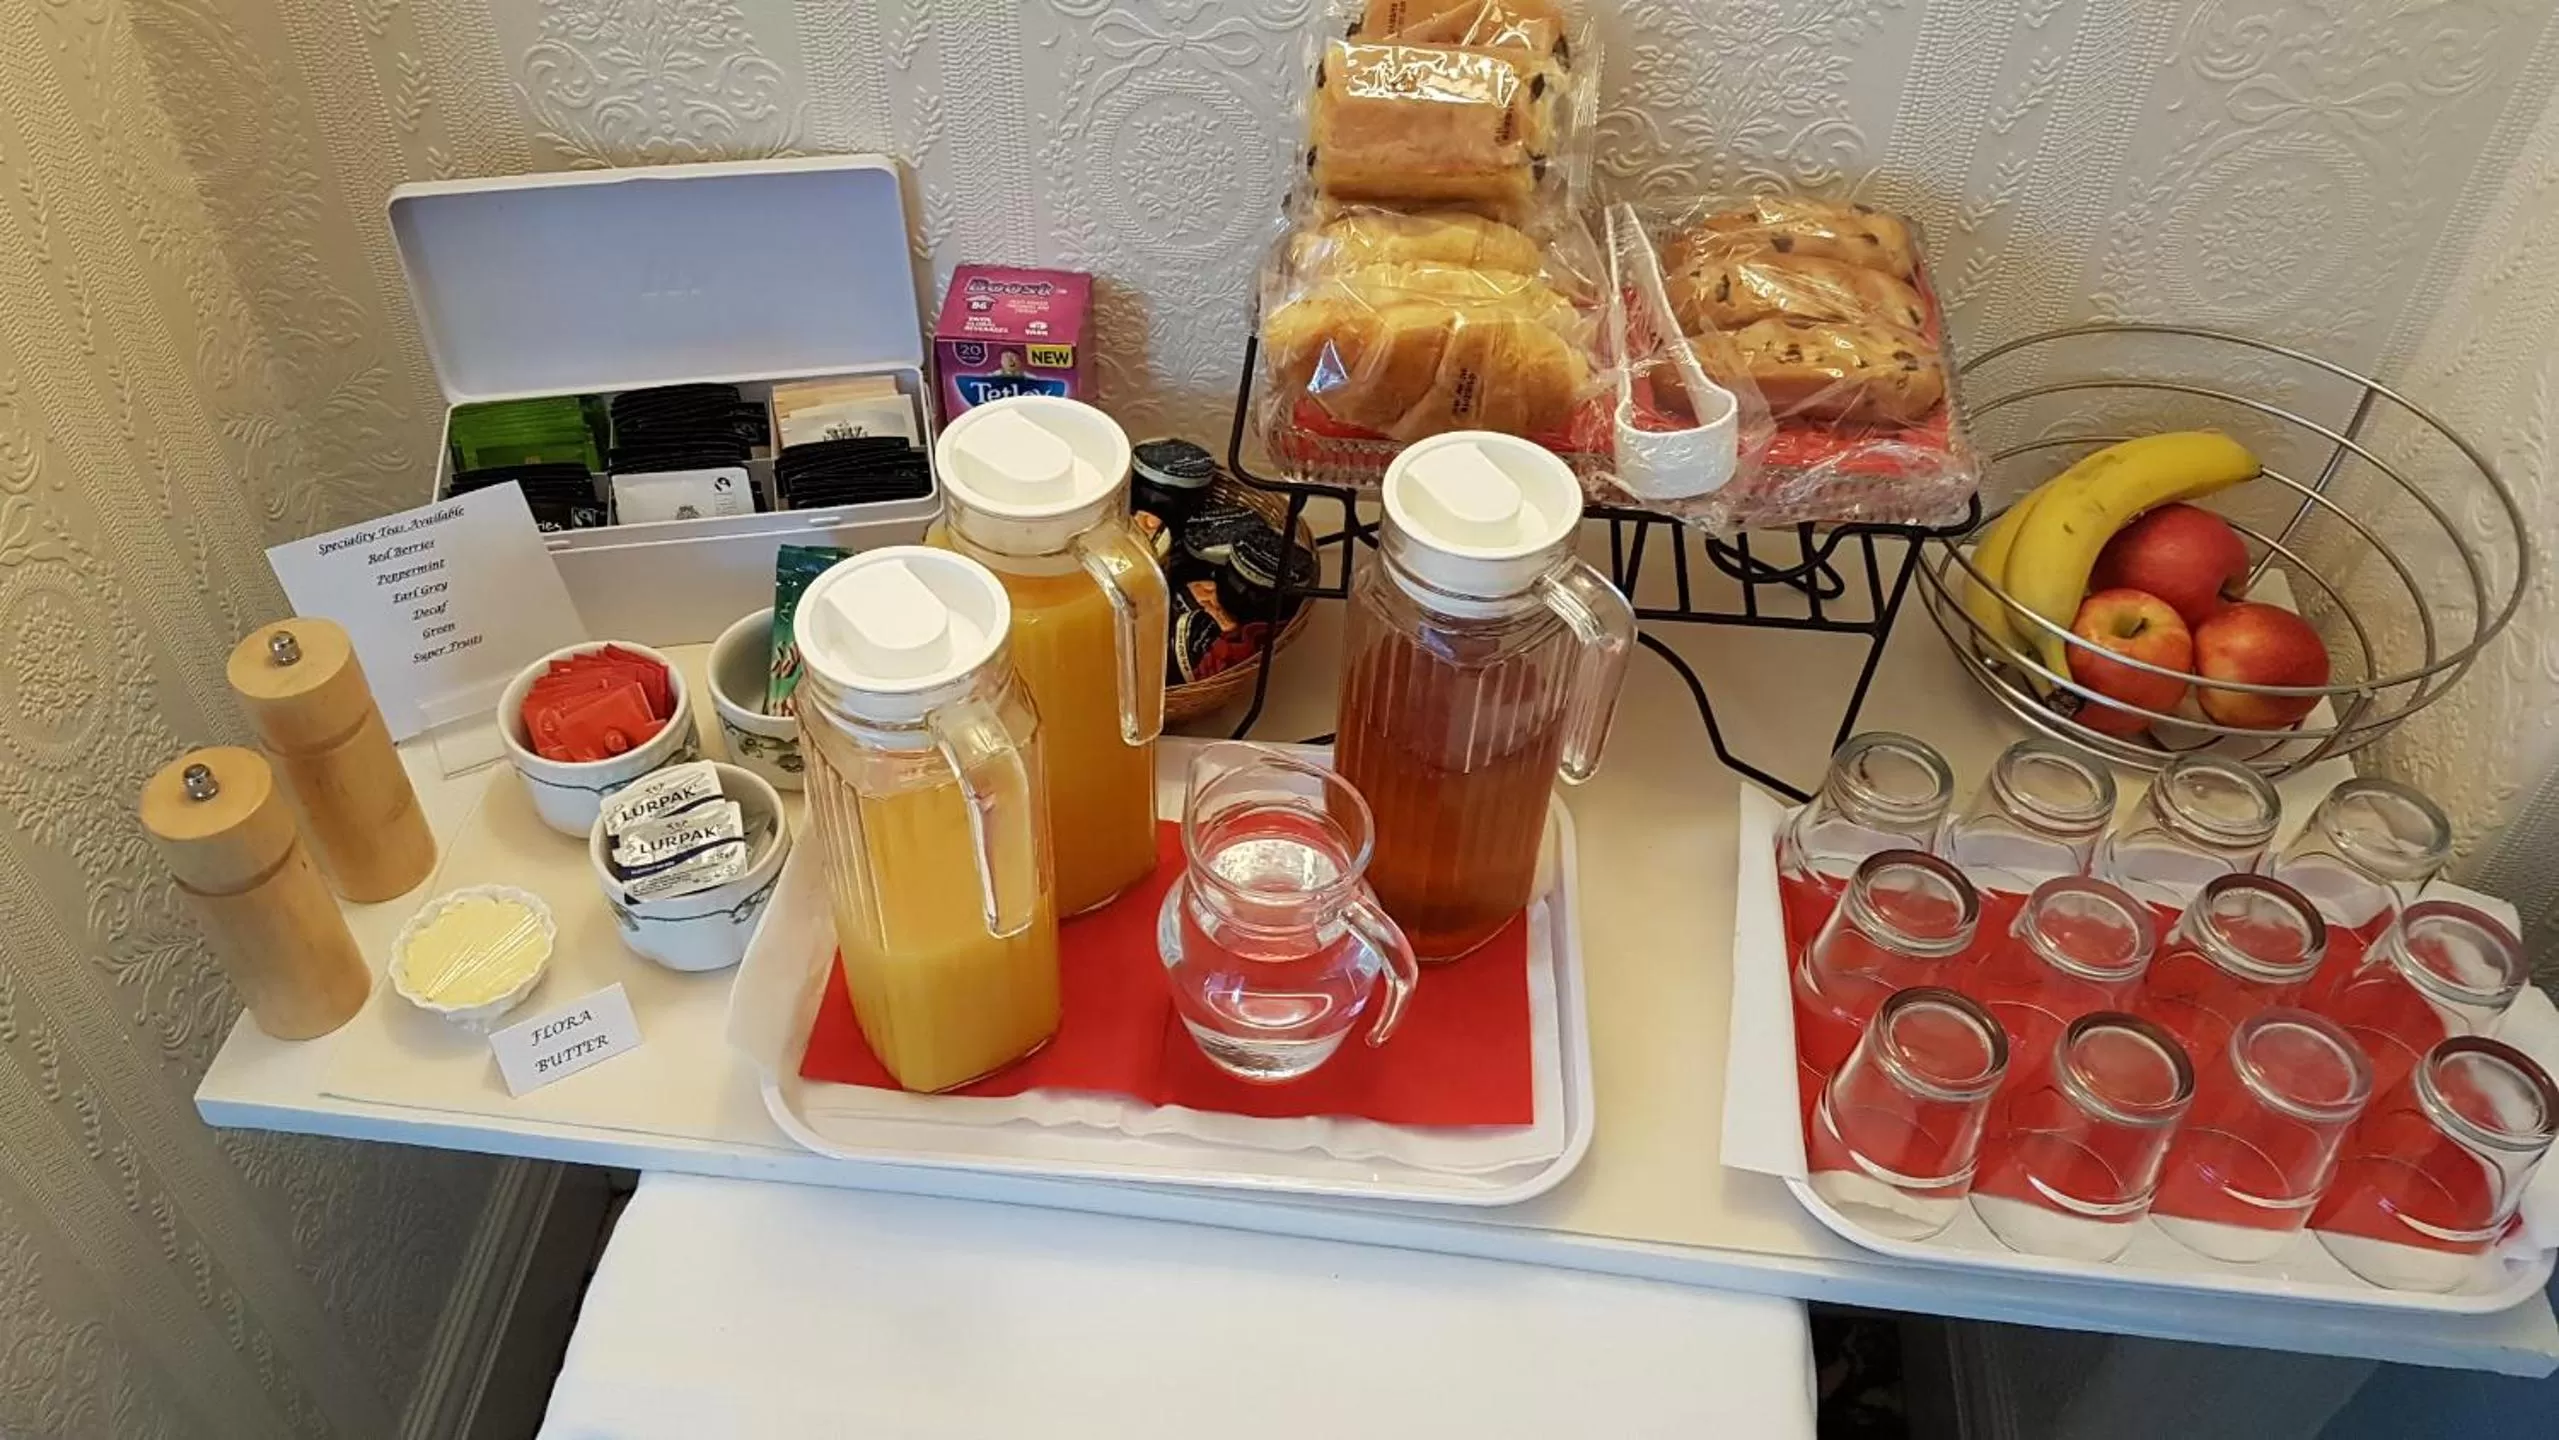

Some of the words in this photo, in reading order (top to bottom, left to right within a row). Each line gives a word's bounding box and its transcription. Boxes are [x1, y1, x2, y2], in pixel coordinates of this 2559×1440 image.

[960, 344, 982, 356] 20
[1031, 350, 1069, 365] NEW
[318, 530, 376, 557] Speciality
[377, 524, 404, 540] Teas
[404, 505, 465, 533] Available
[367, 547, 394, 565] Red
[394, 539, 436, 558] Berries
[376, 558, 446, 586] Peppermint
[393, 586, 420, 604] Earl
[420, 581, 448, 596] Grey
[412, 600, 449, 620] Decaf
[422, 622, 456, 640] Green
[412, 646, 446, 664] Super
[446, 635, 483, 654] Fruits
[621, 786, 697, 821] LURPAK
[640, 826, 718, 854] LURPAK
[531, 1009, 593, 1047] FLORA
[535, 1034, 609, 1074] BUTTER
